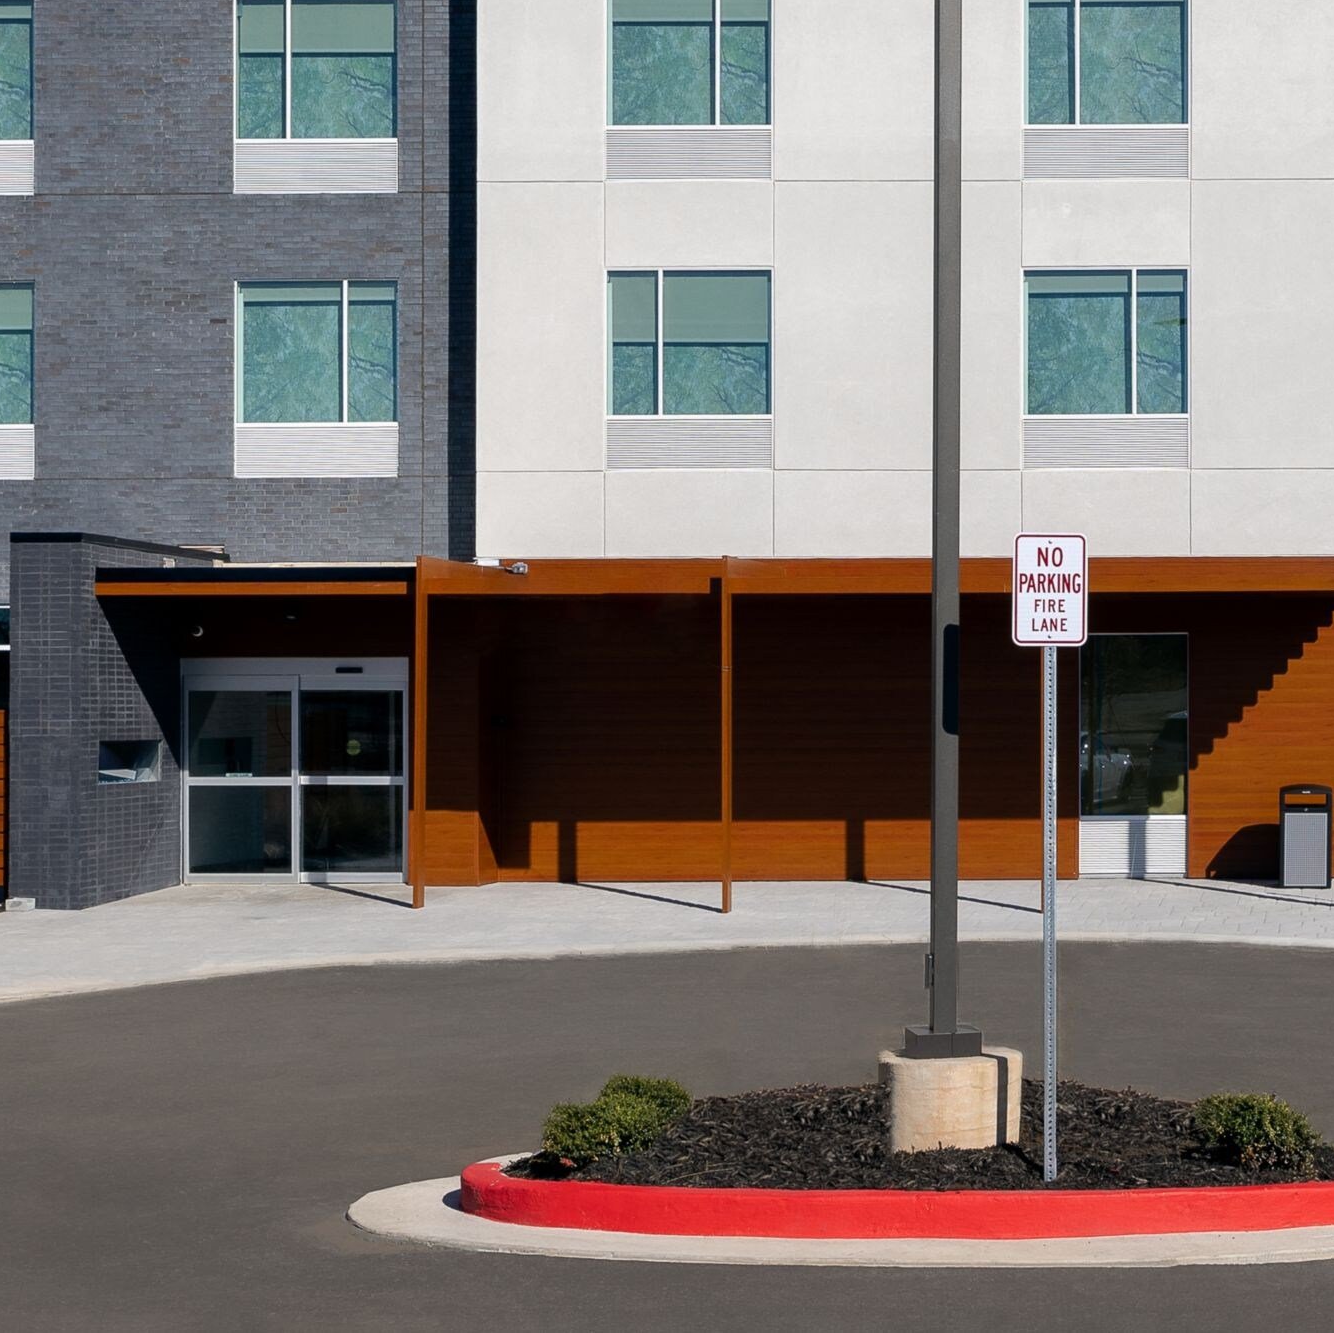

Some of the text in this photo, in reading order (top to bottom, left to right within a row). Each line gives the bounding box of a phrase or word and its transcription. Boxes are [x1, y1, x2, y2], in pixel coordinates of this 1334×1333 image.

[1037, 547, 1063, 567] NO
[1019, 573, 1081, 593] PARKING
[1034, 599, 1065, 613] FIRE
[1032, 618, 1067, 632] LANE
